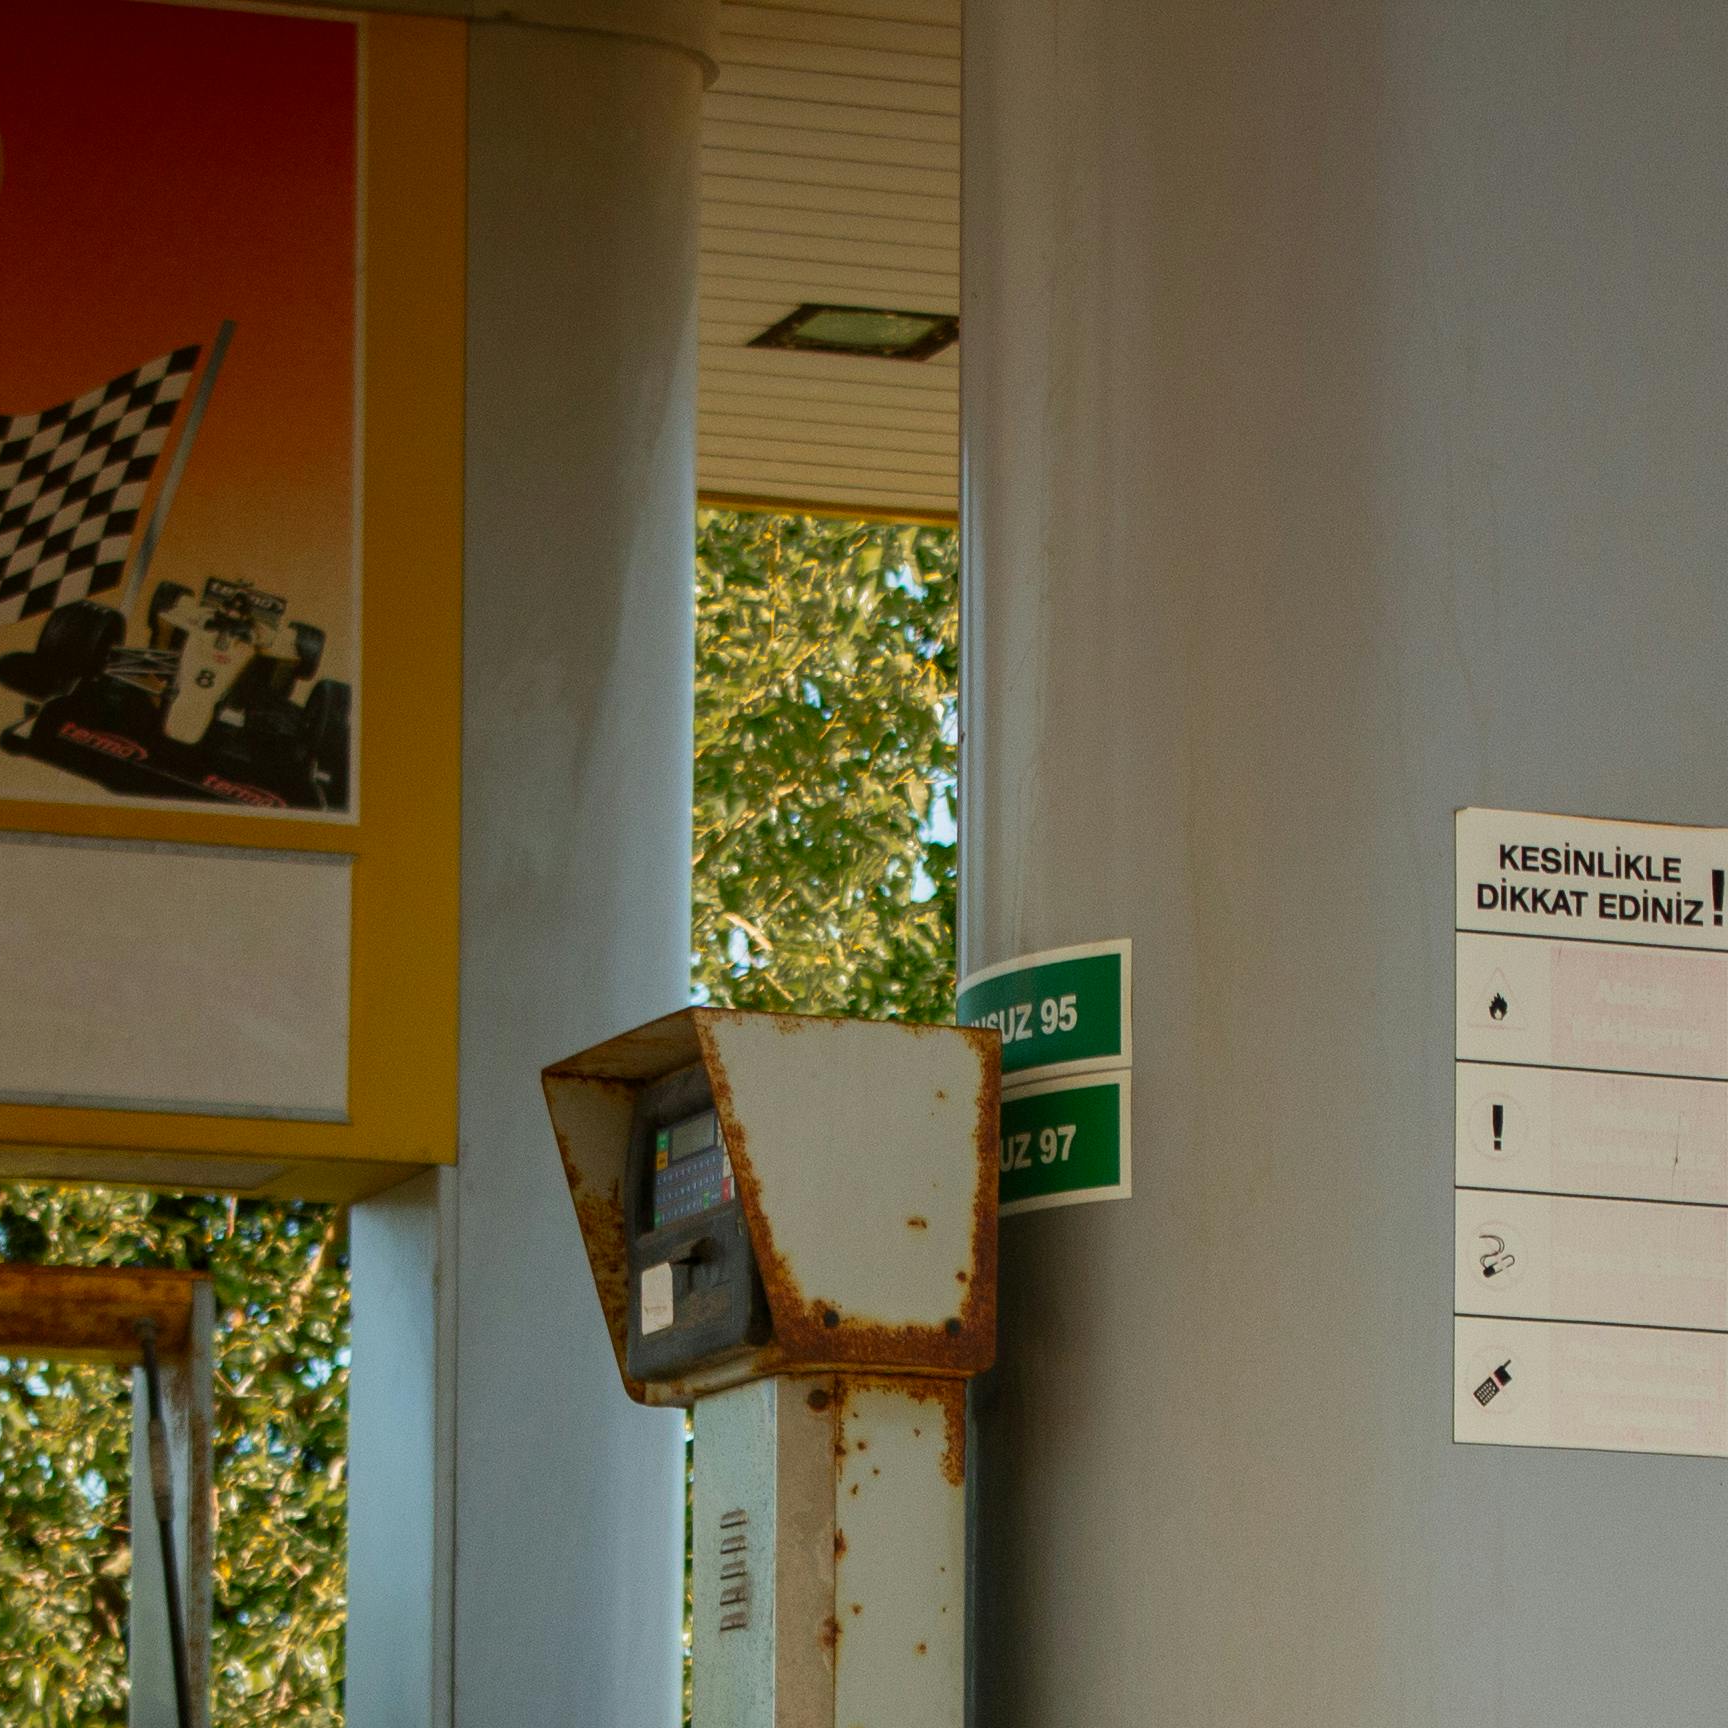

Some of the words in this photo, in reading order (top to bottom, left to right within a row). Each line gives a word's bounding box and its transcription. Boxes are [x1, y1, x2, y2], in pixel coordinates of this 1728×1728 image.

[196, 668, 215, 688] 8
[1499, 842, 1682, 883] KESİNLİKLE
[1477, 878, 1588, 917] DİKKAT
[1598, 889, 1704, 926] EDİNİZ
[1040, 994, 1078, 1035] 95
[1039, 1124, 1077, 1164] 97
